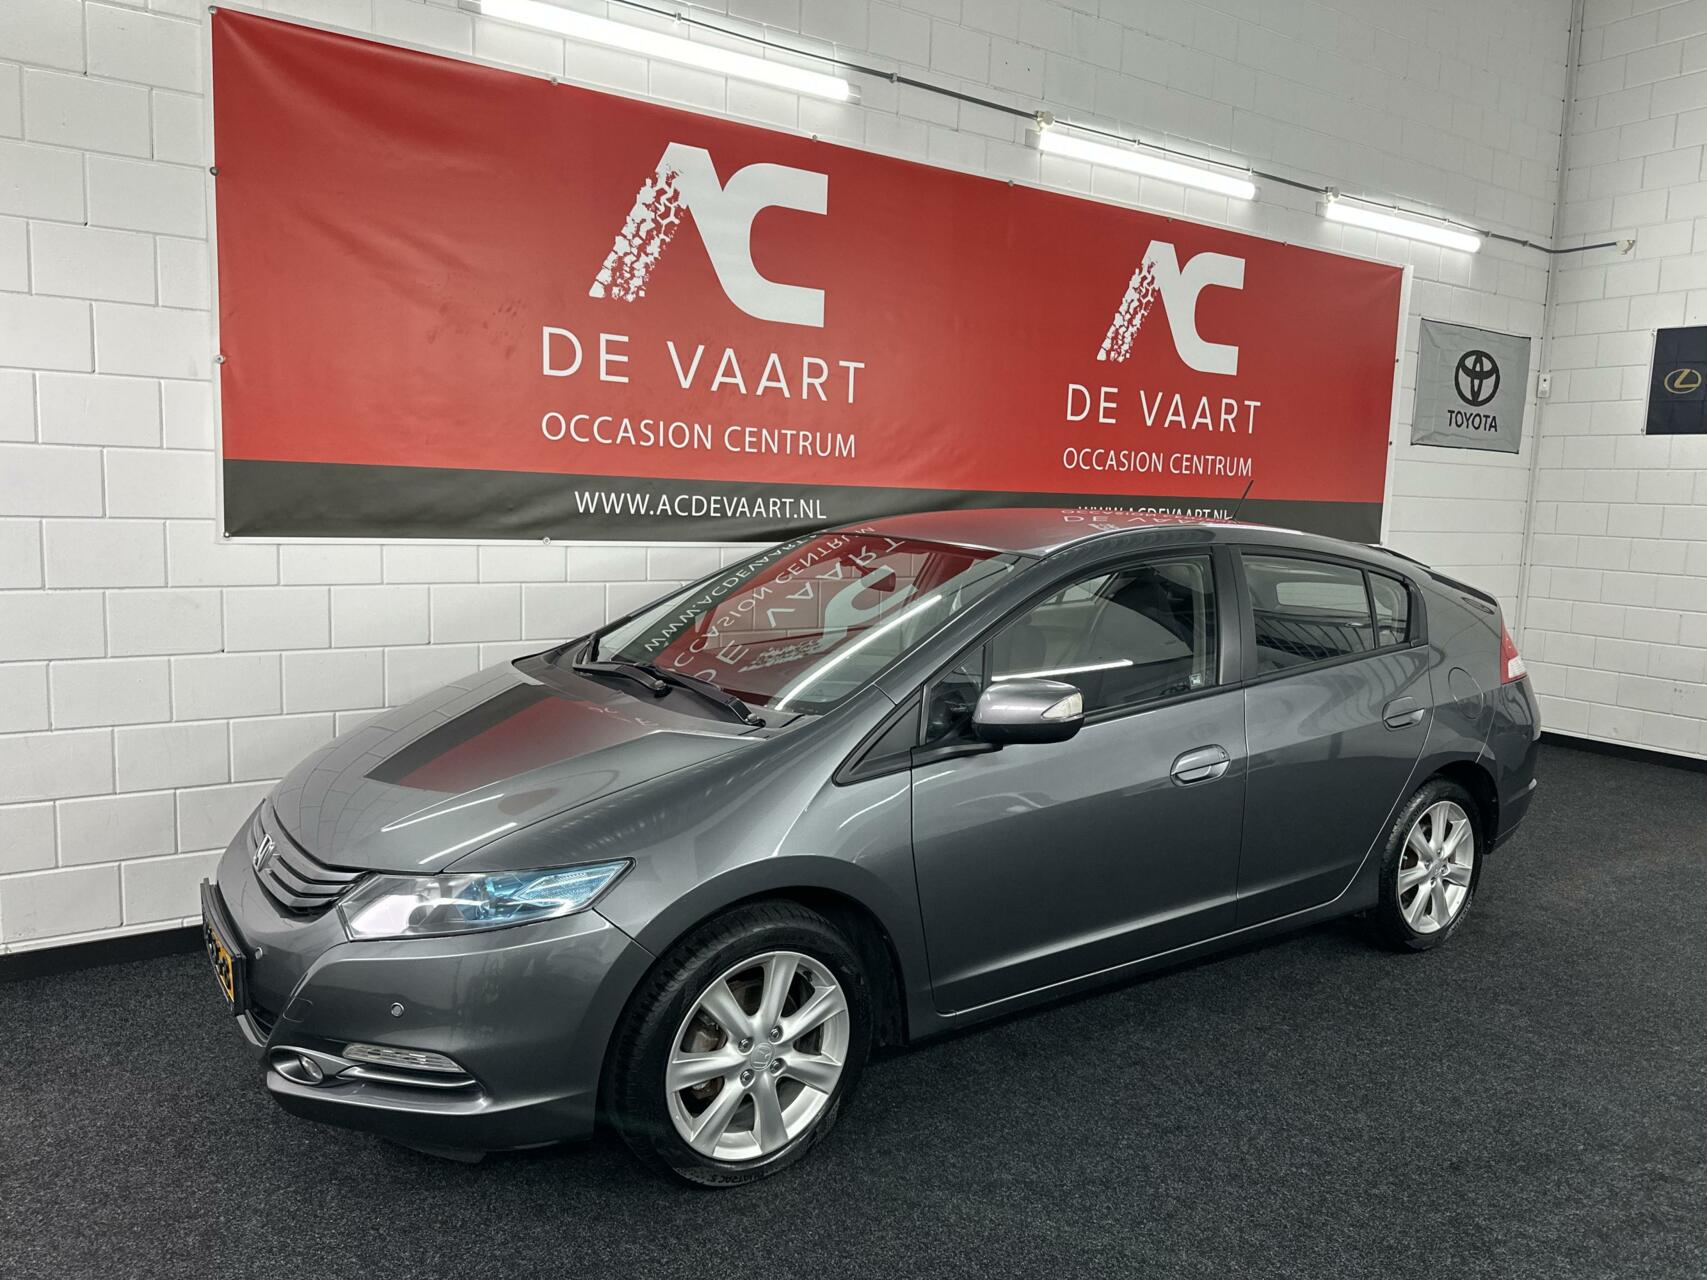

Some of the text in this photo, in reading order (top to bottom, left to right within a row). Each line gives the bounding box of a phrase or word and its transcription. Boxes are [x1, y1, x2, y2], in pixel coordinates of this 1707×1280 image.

[542, 326, 866, 404] DE VAART
[1066, 383, 1262, 434] DE VAART
[1447, 409, 1498, 432] TOYOTA
[541, 411, 856, 458] OCCASION CENTRUM
[1062, 446, 1253, 477] OCCASION CENTRUM
[574, 490, 827, 519] WWW.ACDEVAART.NL
